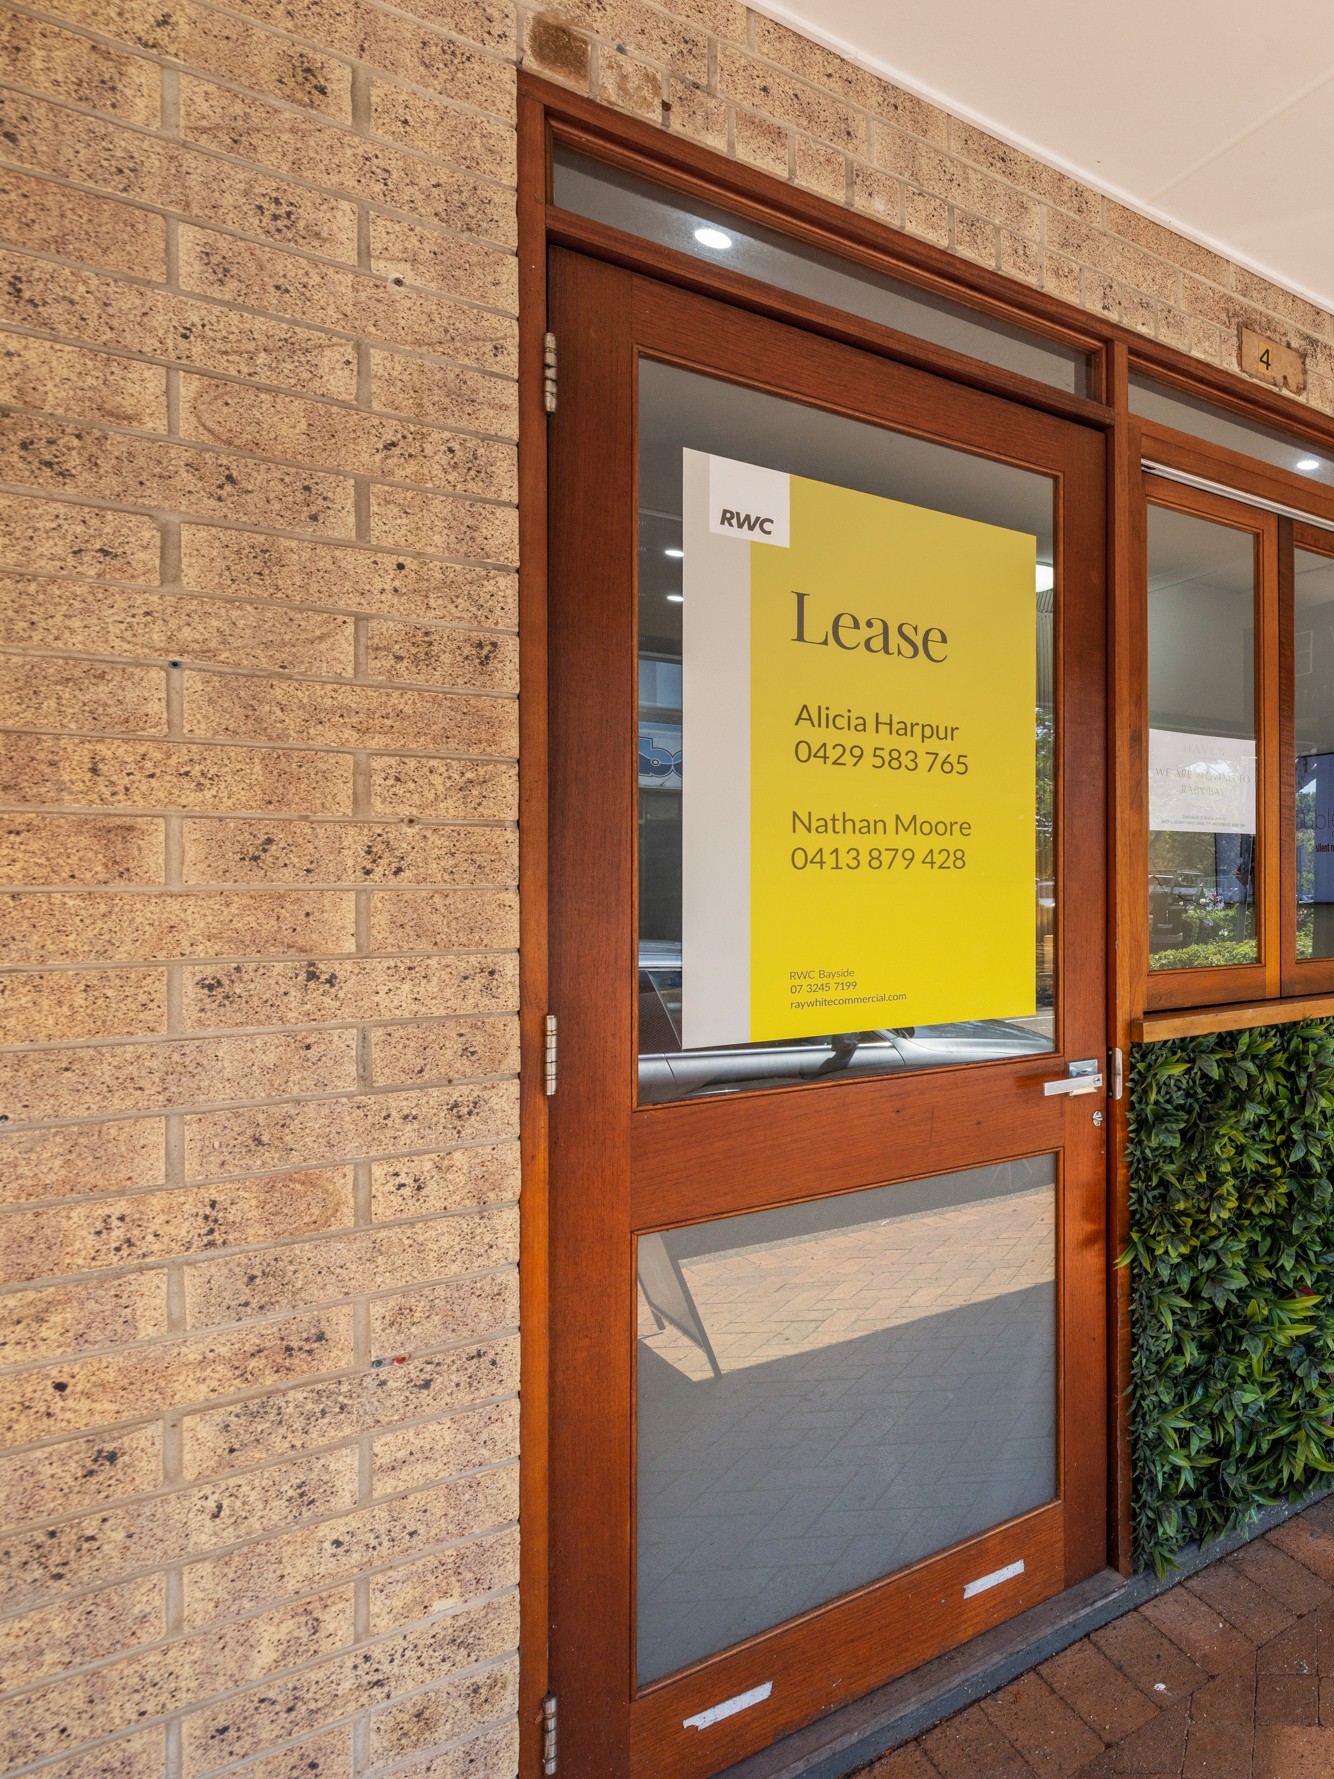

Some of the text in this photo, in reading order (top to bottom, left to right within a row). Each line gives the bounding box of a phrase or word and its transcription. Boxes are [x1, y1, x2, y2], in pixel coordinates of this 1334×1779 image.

[1259, 348, 1272, 371] 4
[719, 508, 775, 536] RWC
[790, 590, 948, 664] Lease
[794, 704, 960, 744] Alicia Harpur
[794, 740, 969, 776] 0429 583 765
[1155, 767, 1170, 778] WE
[1175, 768, 1192, 780] ARE
[1239, 774, 1251, 785] TO
[792, 810, 972, 837] Nathan Moore
[791, 847, 966, 871] 0413 879 428
[789, 968, 855, 981] RWC Bayside
[790, 980, 858, 995] 07 3245 7199
[790, 990, 907, 1010] raywhitecommercial.com
